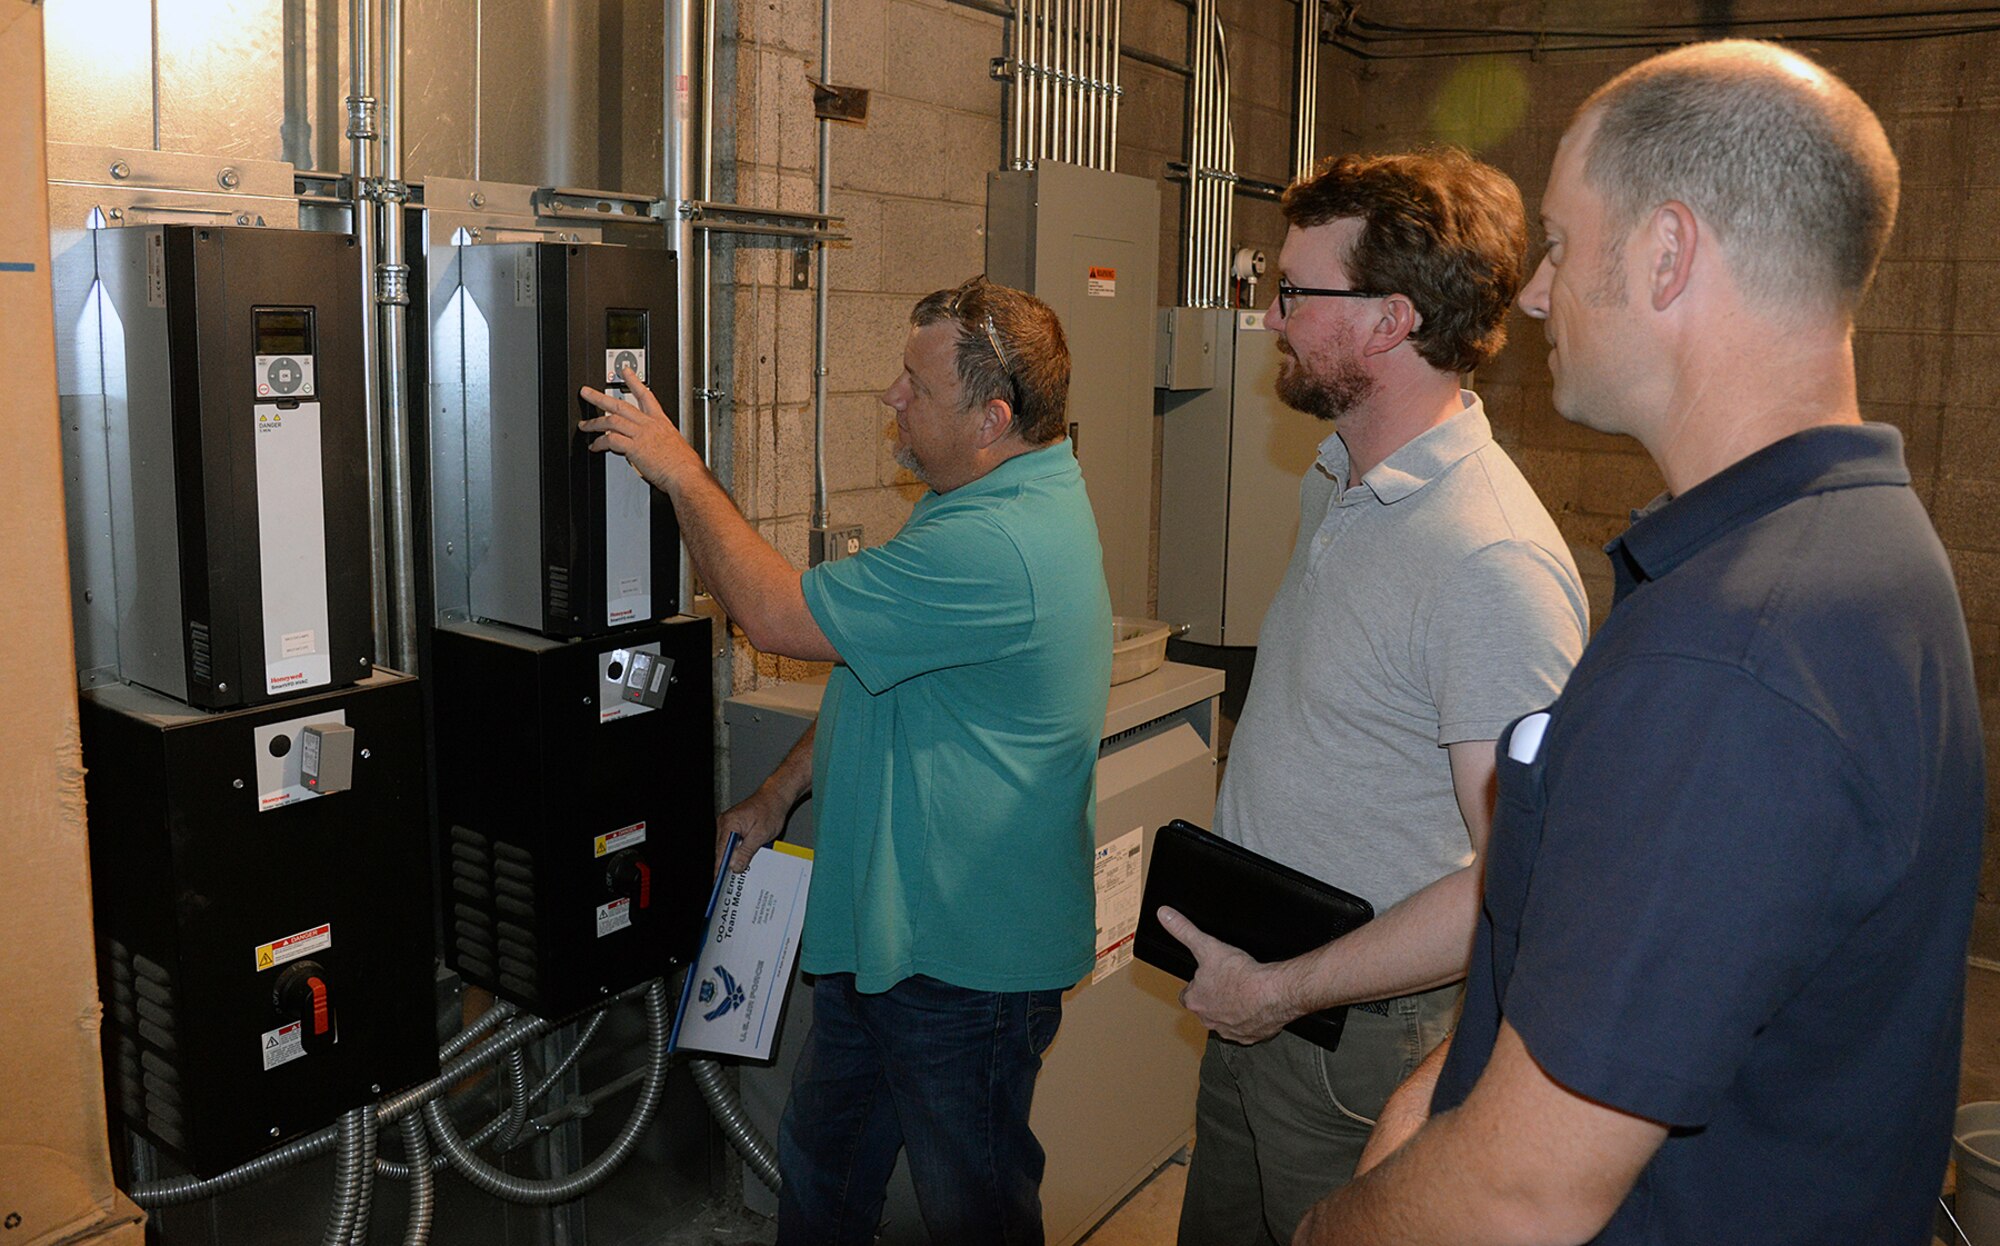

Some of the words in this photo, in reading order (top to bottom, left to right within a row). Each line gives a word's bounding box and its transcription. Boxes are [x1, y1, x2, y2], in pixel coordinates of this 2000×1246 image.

[270, 672, 303, 684] Honeywell
[716, 897, 732, 943] OO-ALC
[726, 873, 738, 895] Ene
[724, 909, 738, 939] Team
[290, 929, 318, 944] DANGER
[749, 959, 765, 999] FORCE
[745, 1000, 755, 1021] AIR
[739, 1020, 750, 1043] U.S.
